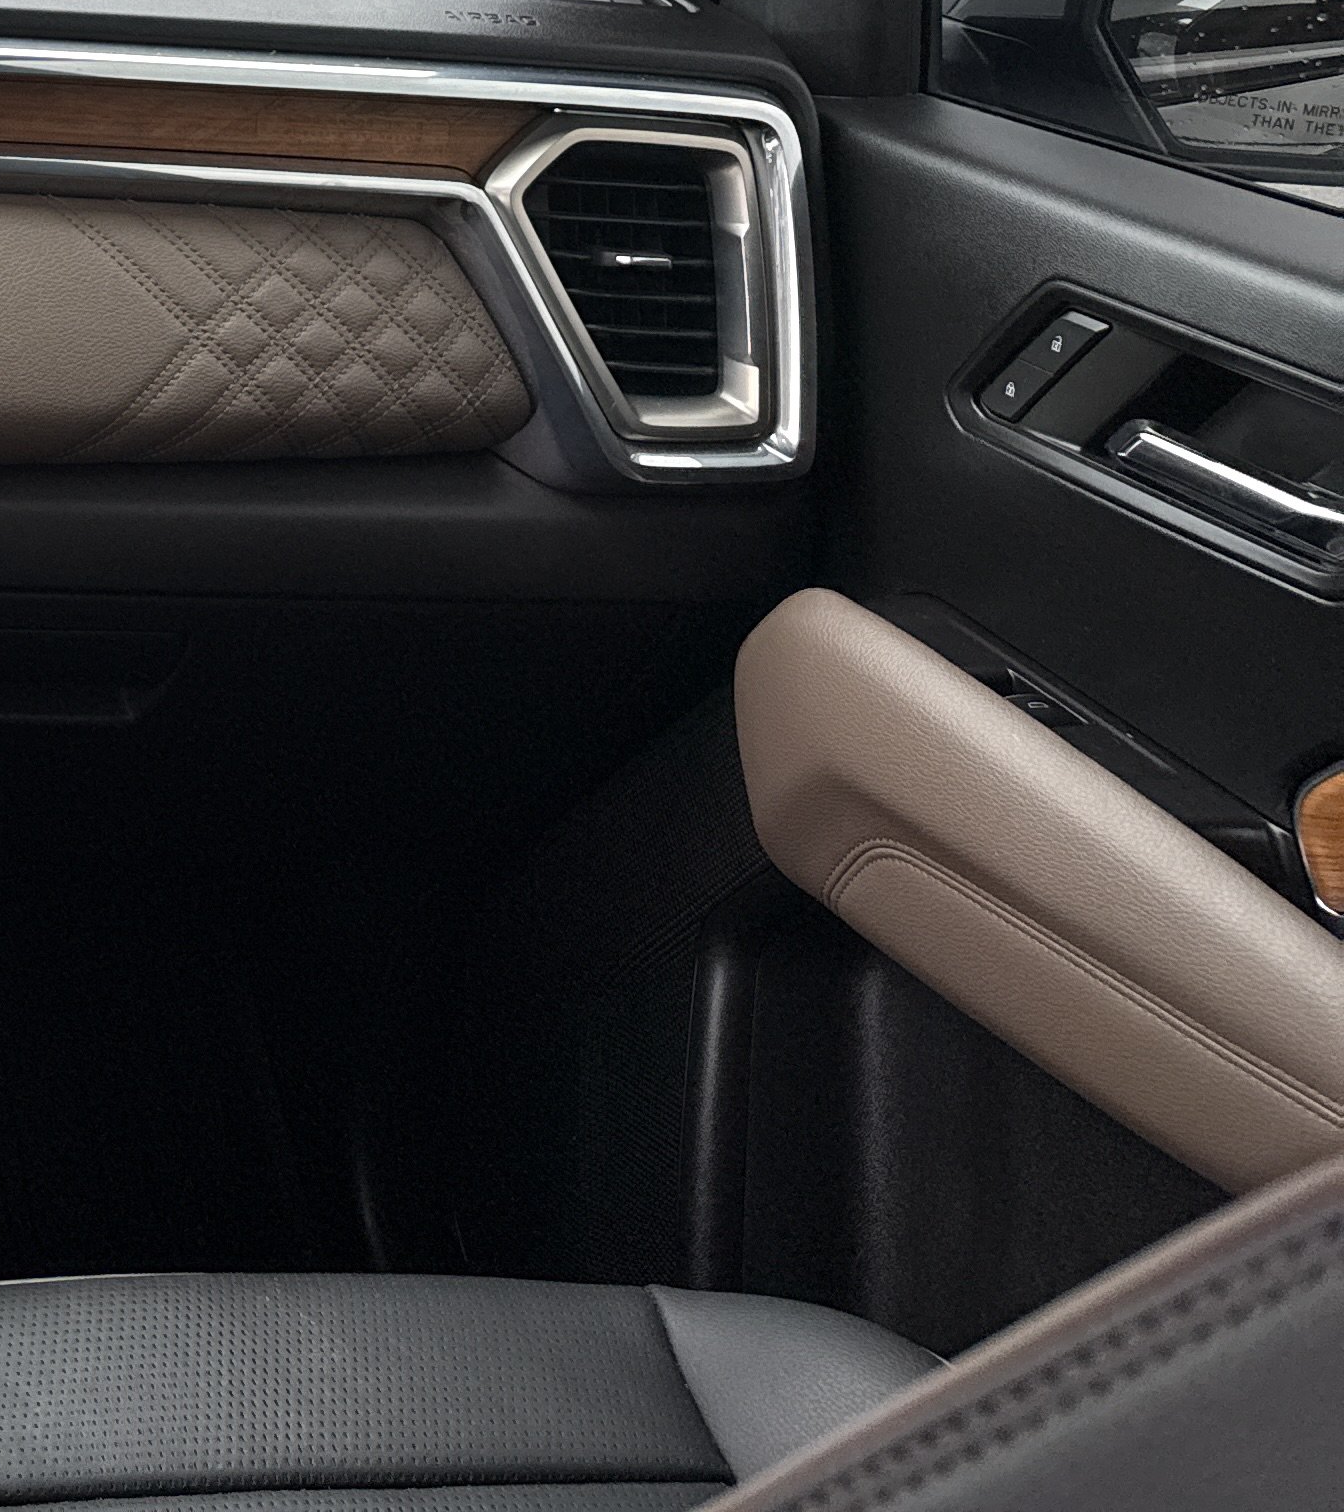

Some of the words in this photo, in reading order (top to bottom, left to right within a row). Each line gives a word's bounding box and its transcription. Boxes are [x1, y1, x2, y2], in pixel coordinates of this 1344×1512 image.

[444, 10, 540, 28] AIRBAG
[1303, 103, 1344, 120] MIRR
[1252, 114, 1295, 131] THAN
